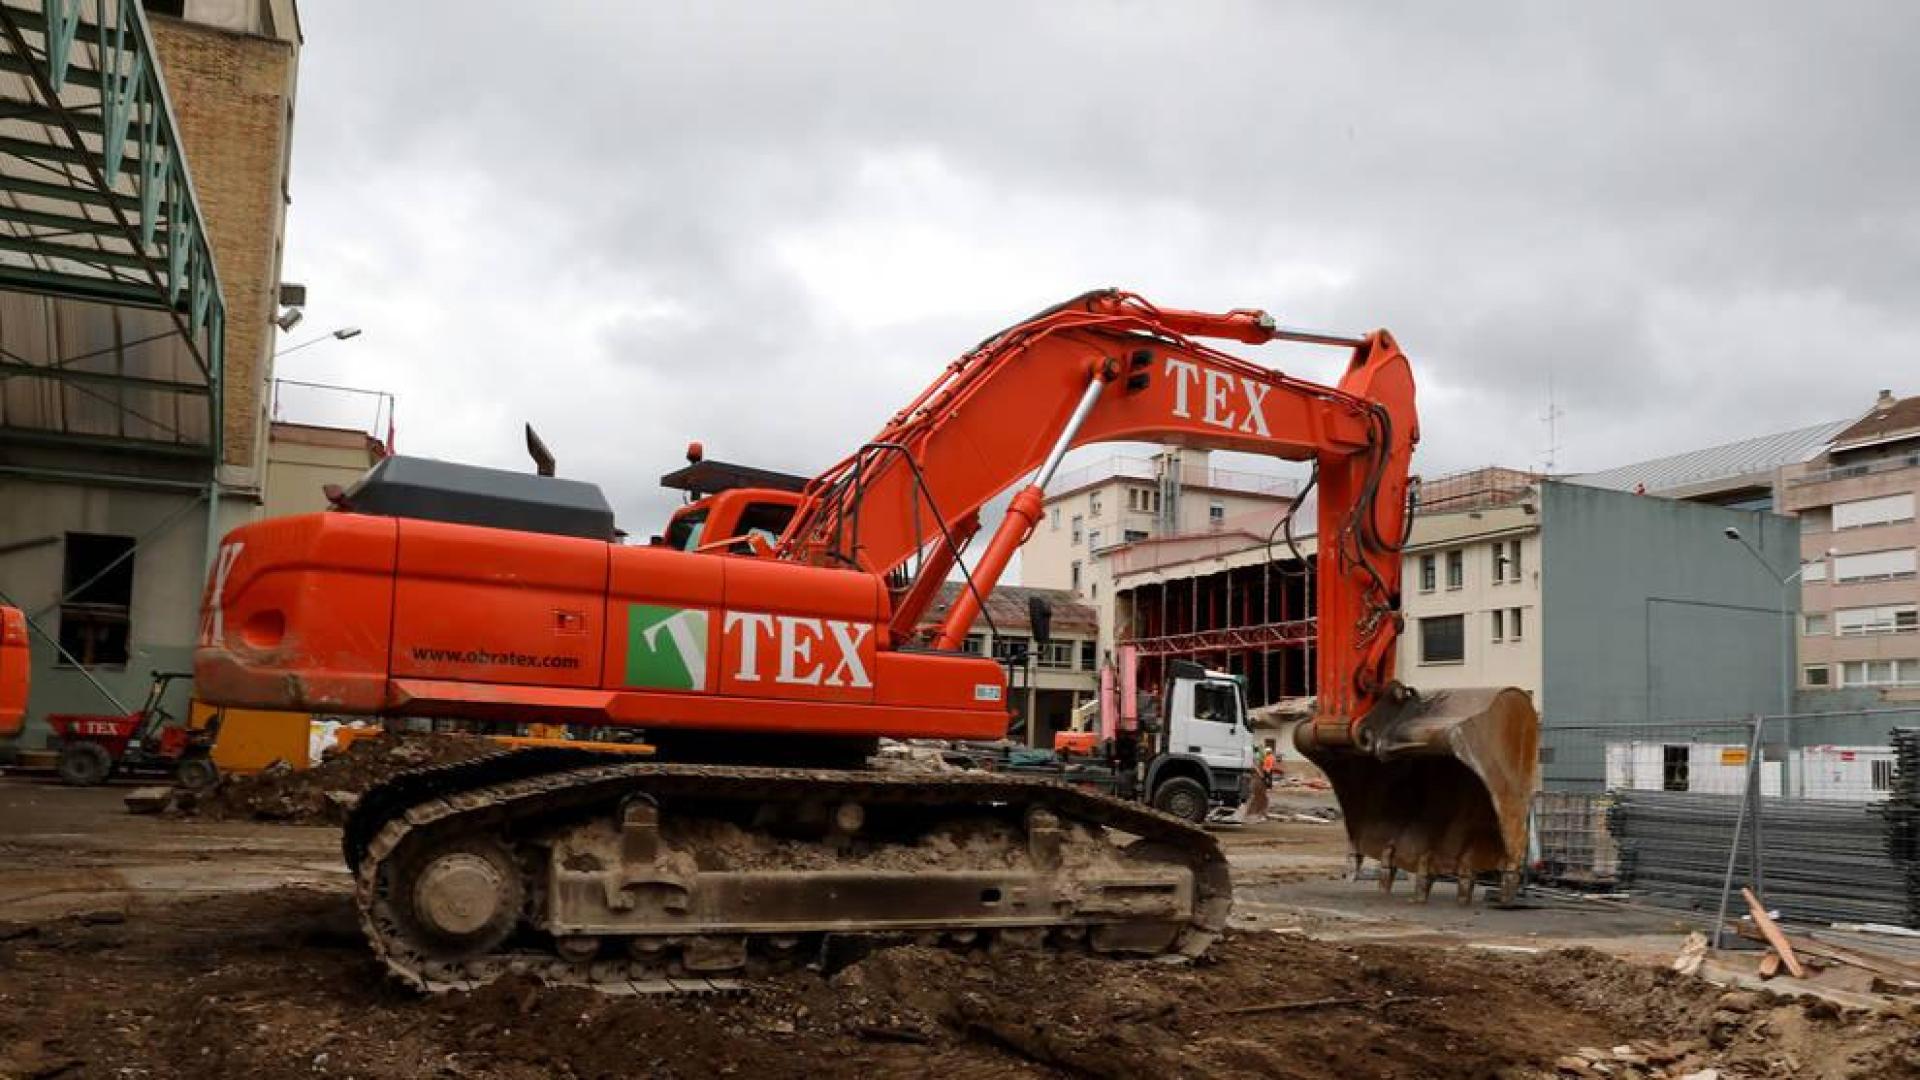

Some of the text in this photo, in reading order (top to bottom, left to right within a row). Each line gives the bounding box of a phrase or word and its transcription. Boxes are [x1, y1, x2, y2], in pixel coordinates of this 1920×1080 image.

[1165, 358, 1271, 437] TEX
[412, 647, 579, 669] www.obratex.com
[723, 610, 874, 688] TEX
[86, 720, 119, 735] TEX
